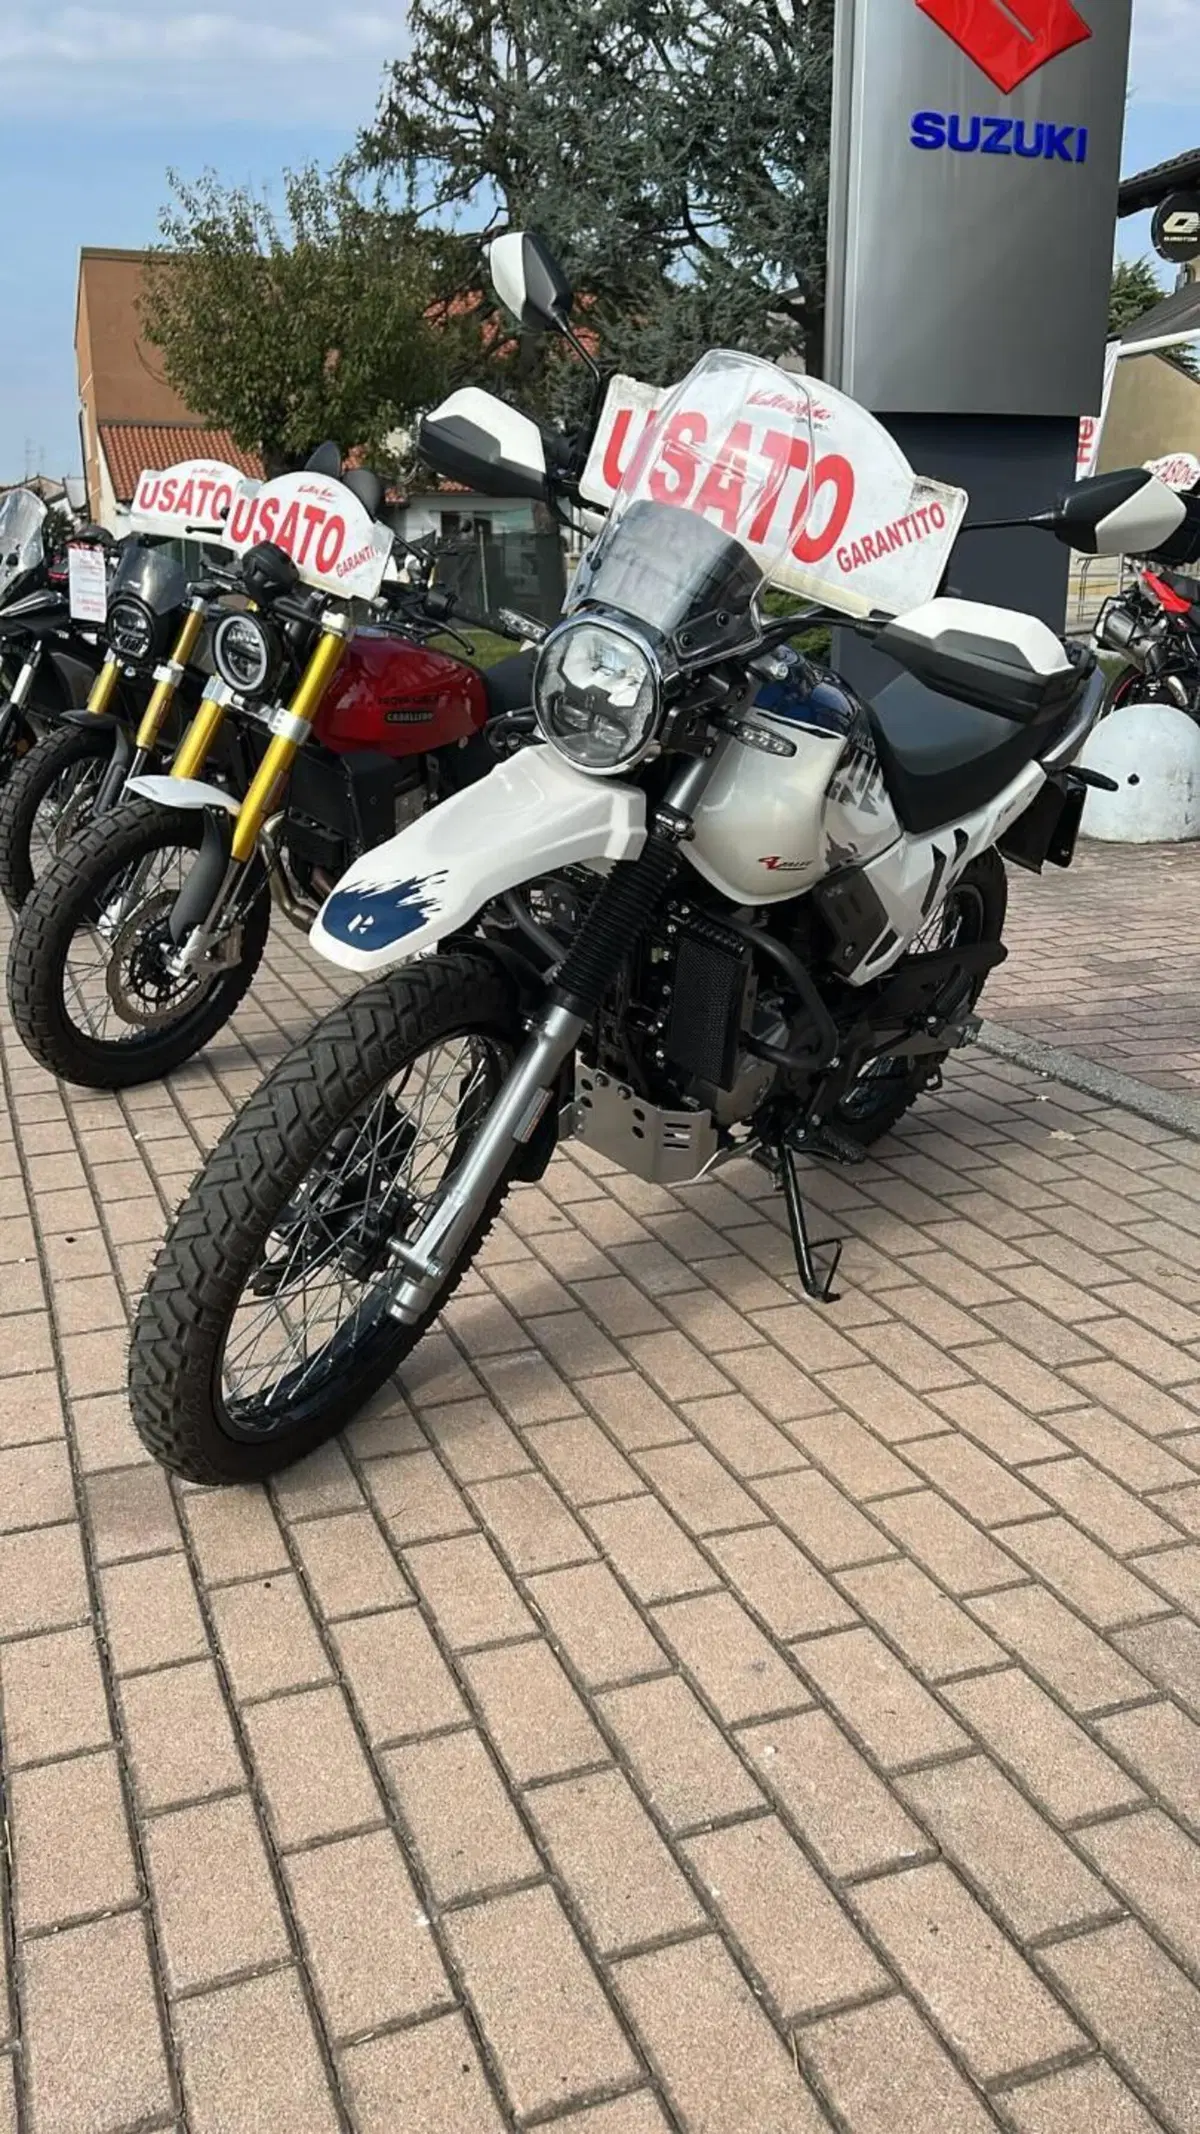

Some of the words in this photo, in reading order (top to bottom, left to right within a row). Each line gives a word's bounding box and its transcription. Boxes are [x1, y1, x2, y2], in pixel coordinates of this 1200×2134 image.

[910, 112, 1088, 163] SUZUKI
[139, 478, 233, 521] USATO
[602, 408, 856, 564] USATO
[230, 496, 346, 574] USATO
[836, 500, 946, 574] GARANTITO
